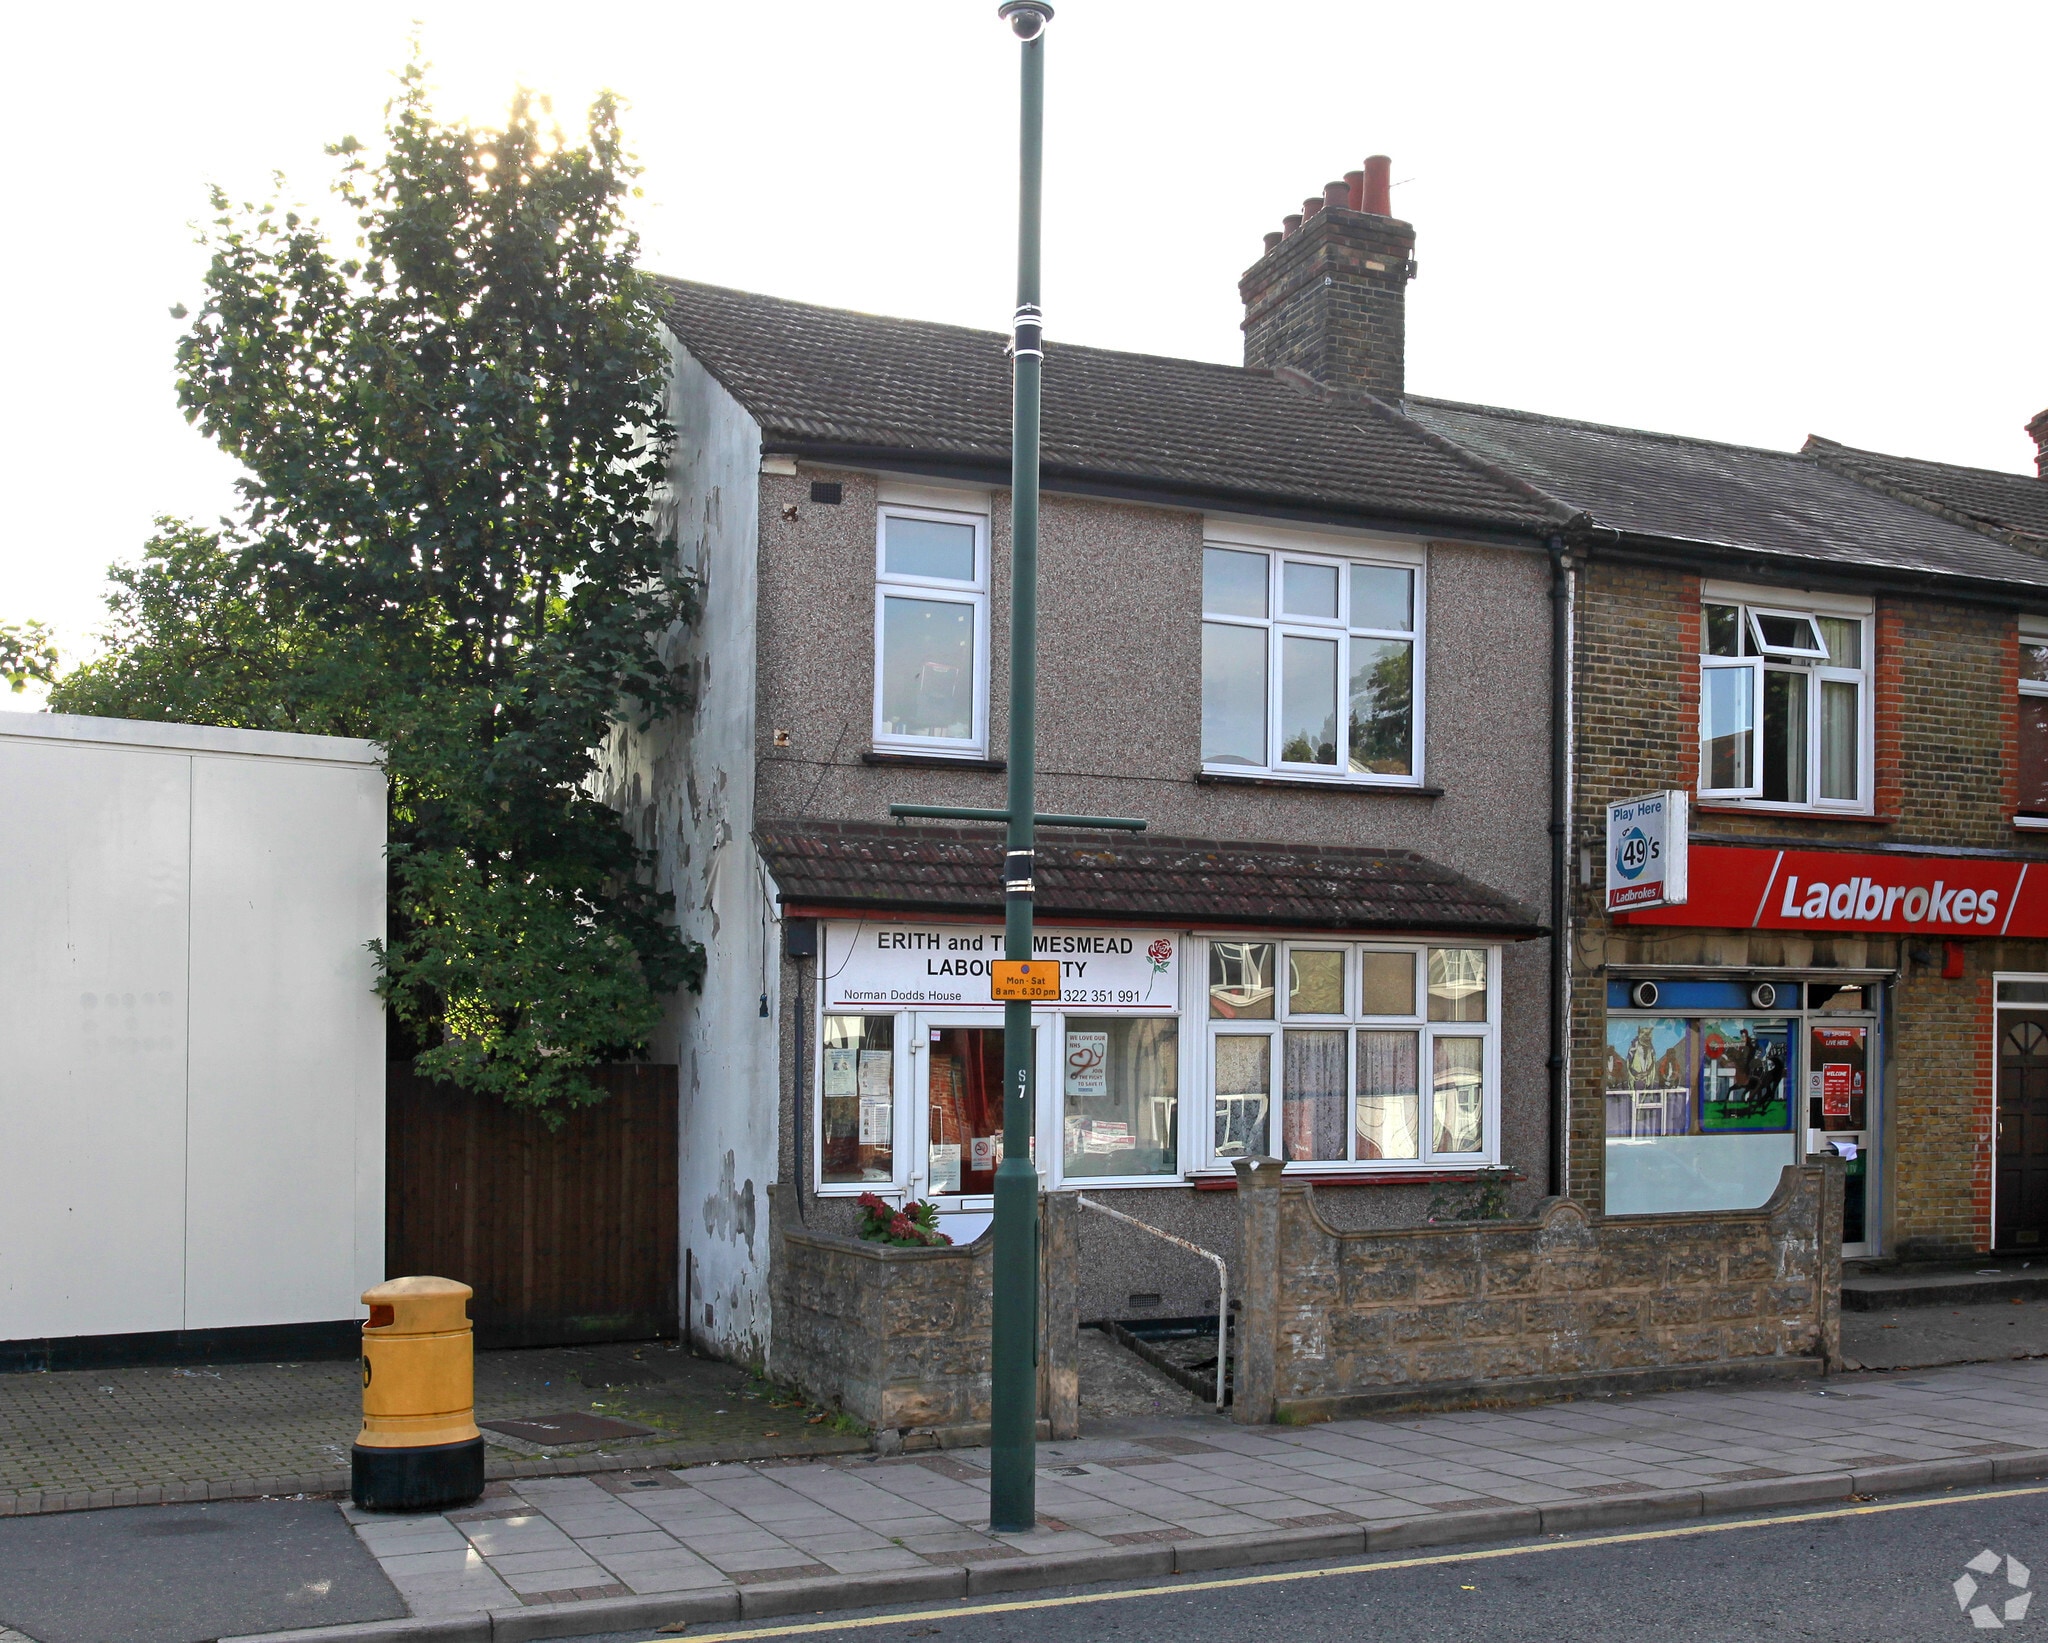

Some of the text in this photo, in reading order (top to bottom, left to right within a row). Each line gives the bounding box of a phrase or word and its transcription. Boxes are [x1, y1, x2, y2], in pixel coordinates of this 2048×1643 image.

[1613, 802, 1661, 822] Play Here
[1623, 836, 1660, 866] 49's
[1616, 887, 1657, 903] Ladbrokes
[1780, 875, 1999, 926] Ladbrokes
[877, 932, 1133, 954] ERITH and TMESMEAD
[927, 959, 992, 977] LABO
[1006, 977, 1025, 985] Mon
[1031, 977, 1045, 985] Sat
[844, 990, 962, 1001] Norman Dodds House
[995, 988, 1001, 996] 8
[1021, 988, 1042, 996] 6.30
[1043, 989, 1056, 997] pm
[1091, 990, 1113, 1002] 351
[1118, 990, 1140, 1002] 991
[1018, 1085, 1026, 1099] 7
